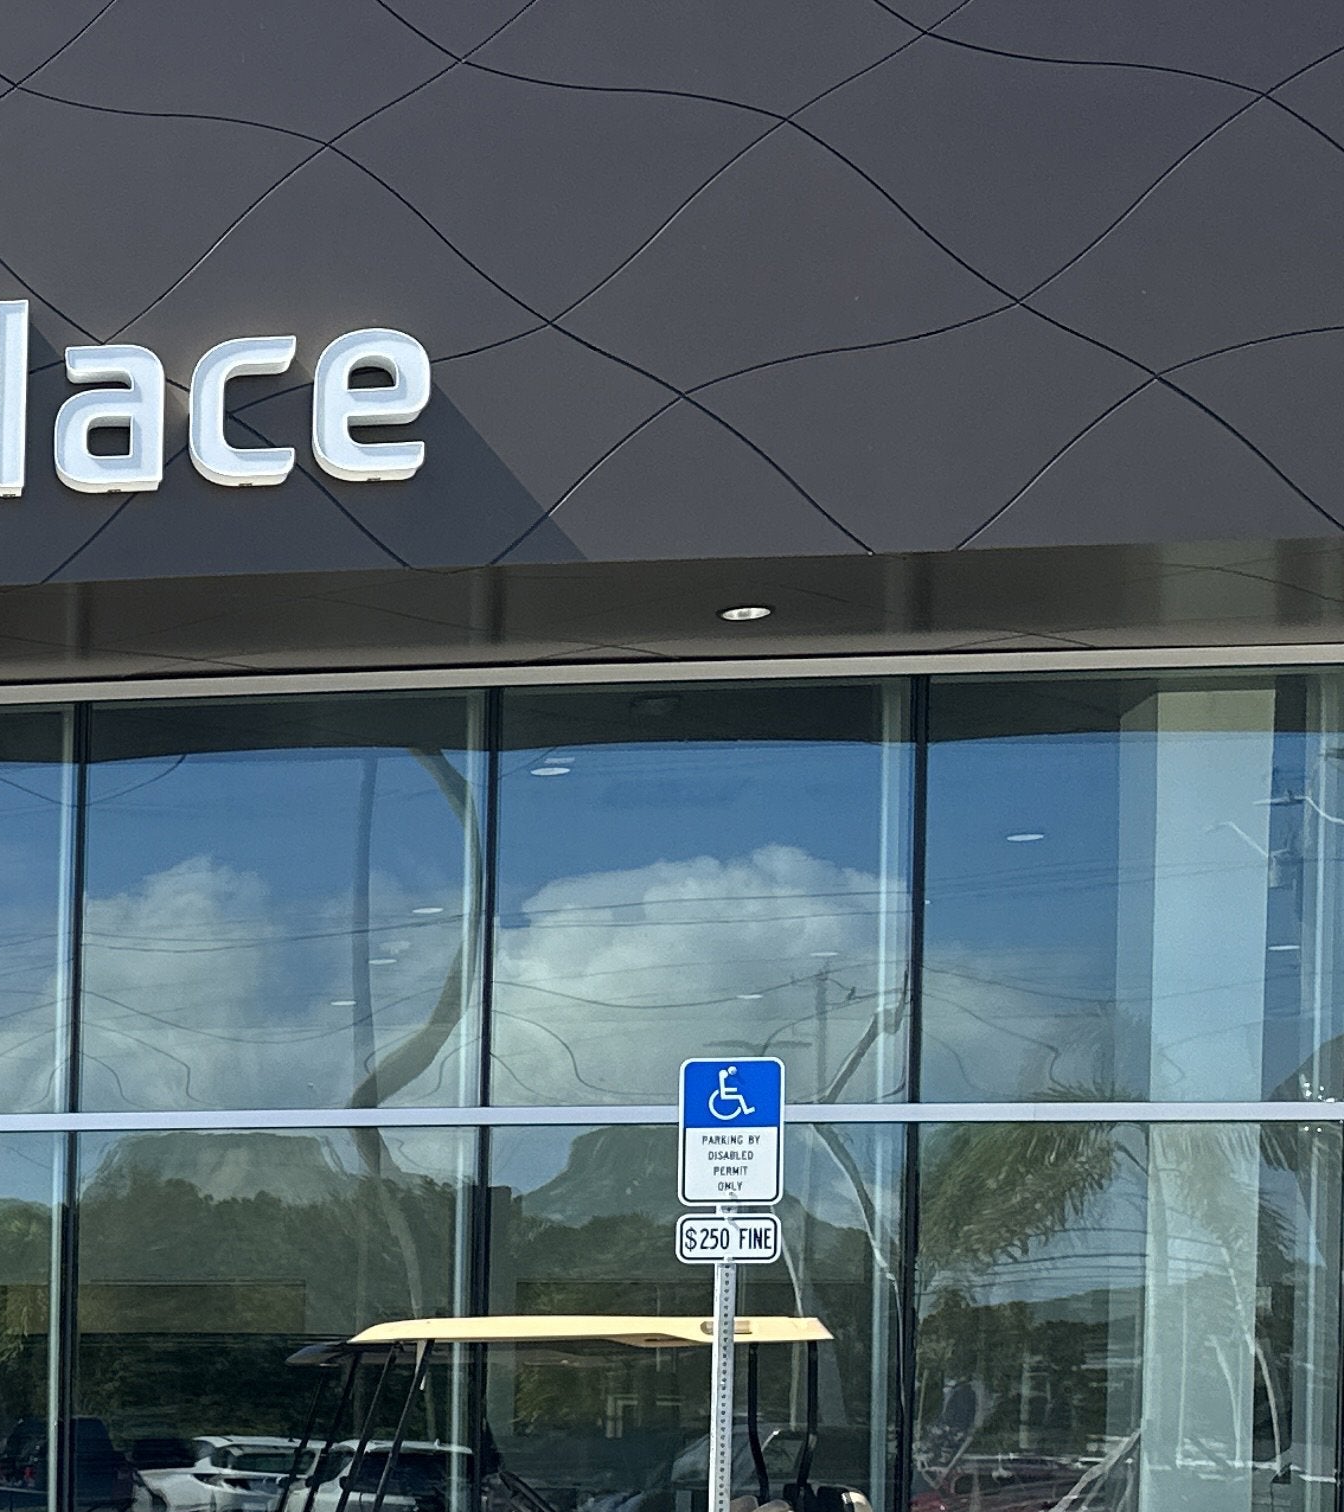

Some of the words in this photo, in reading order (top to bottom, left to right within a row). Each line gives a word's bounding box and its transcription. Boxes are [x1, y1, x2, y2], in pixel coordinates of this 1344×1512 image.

[702, 1135, 743, 1145] PARKING
[749, 1135, 760, 1144] BY
[708, 1151, 754, 1160] DISABLED
[713, 1166, 748, 1176] PERMIT
[717, 1181, 743, 1191] ONLY
[685, 1227, 729, 1251] $250
[739, 1228, 772, 1250] FINE
